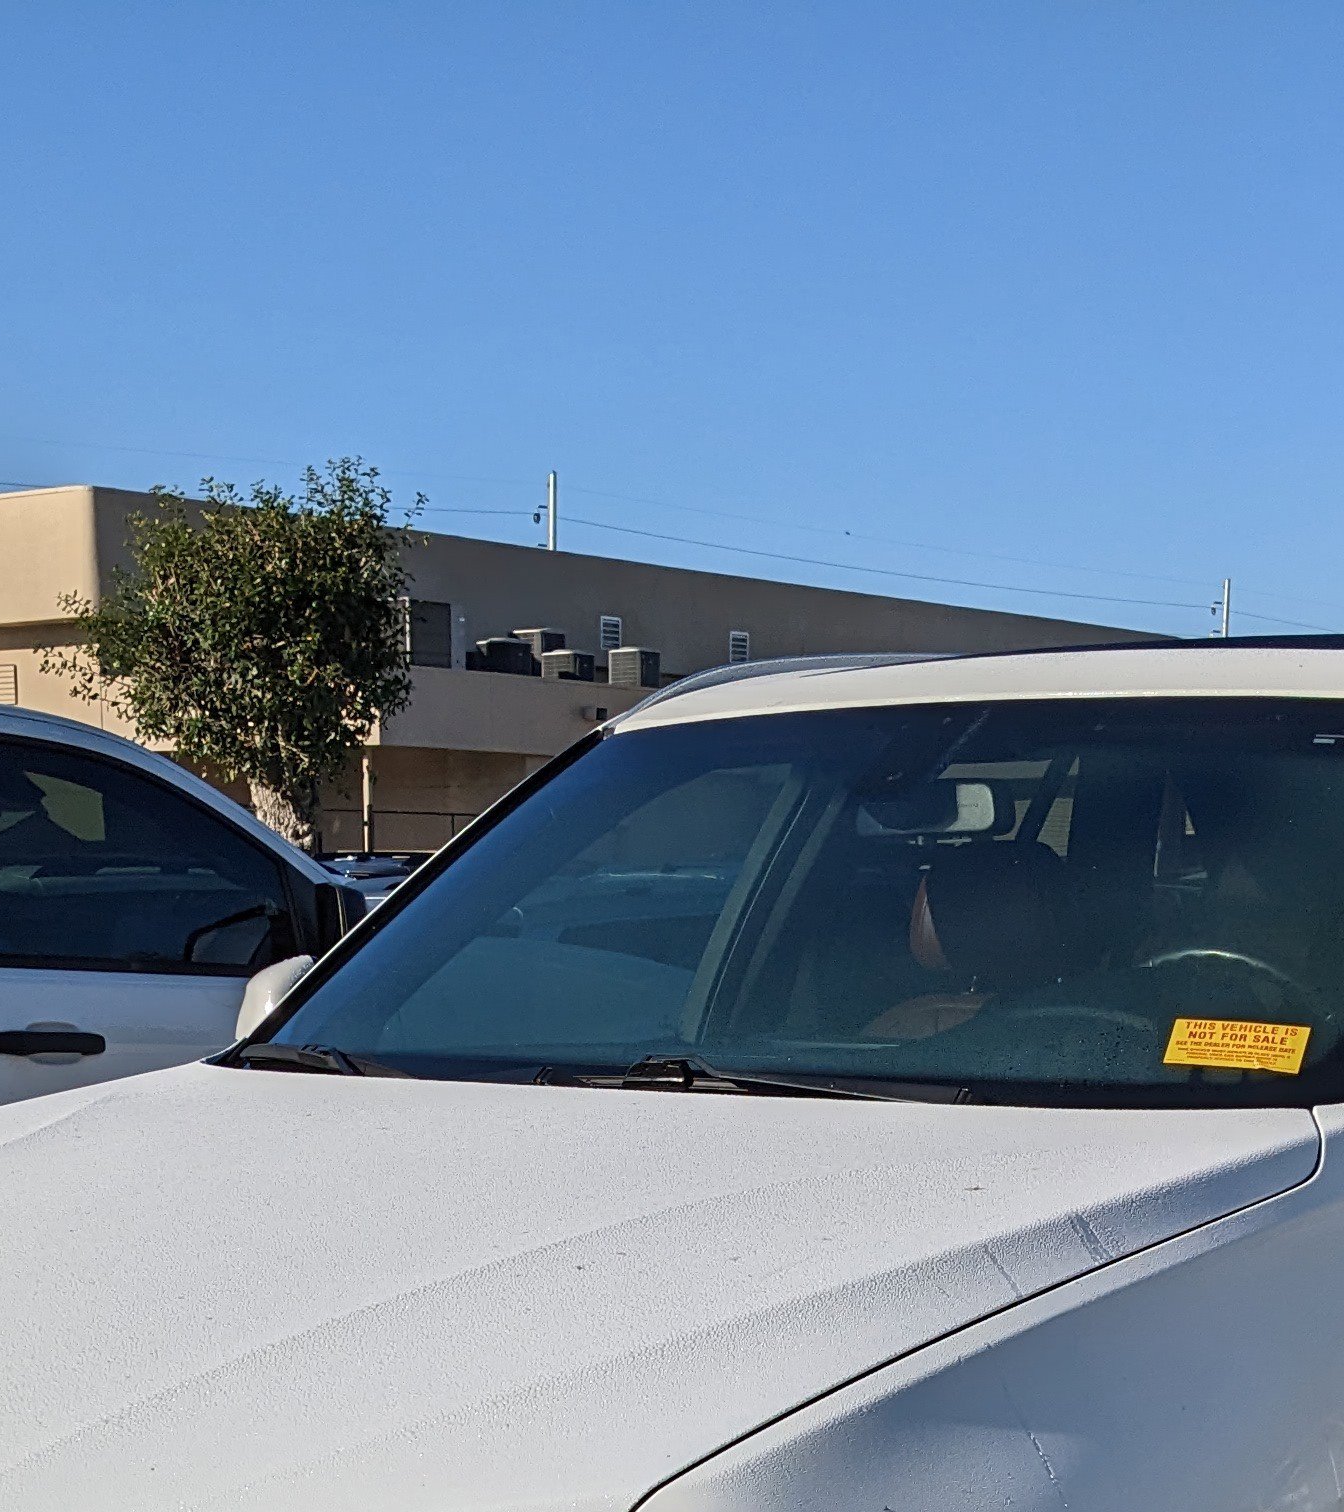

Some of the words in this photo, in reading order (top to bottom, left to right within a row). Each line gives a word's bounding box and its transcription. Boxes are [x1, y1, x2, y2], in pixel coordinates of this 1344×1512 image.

[1185, 1021, 1216, 1030] THIS
[1221, 1022, 1279, 1034] VEHICLE
[1285, 1027, 1299, 1036] IS
[1188, 1030, 1216, 1040] NOT
[1221, 1032, 1248, 1042] FOR
[1253, 1034, 1288, 1045] SALE
